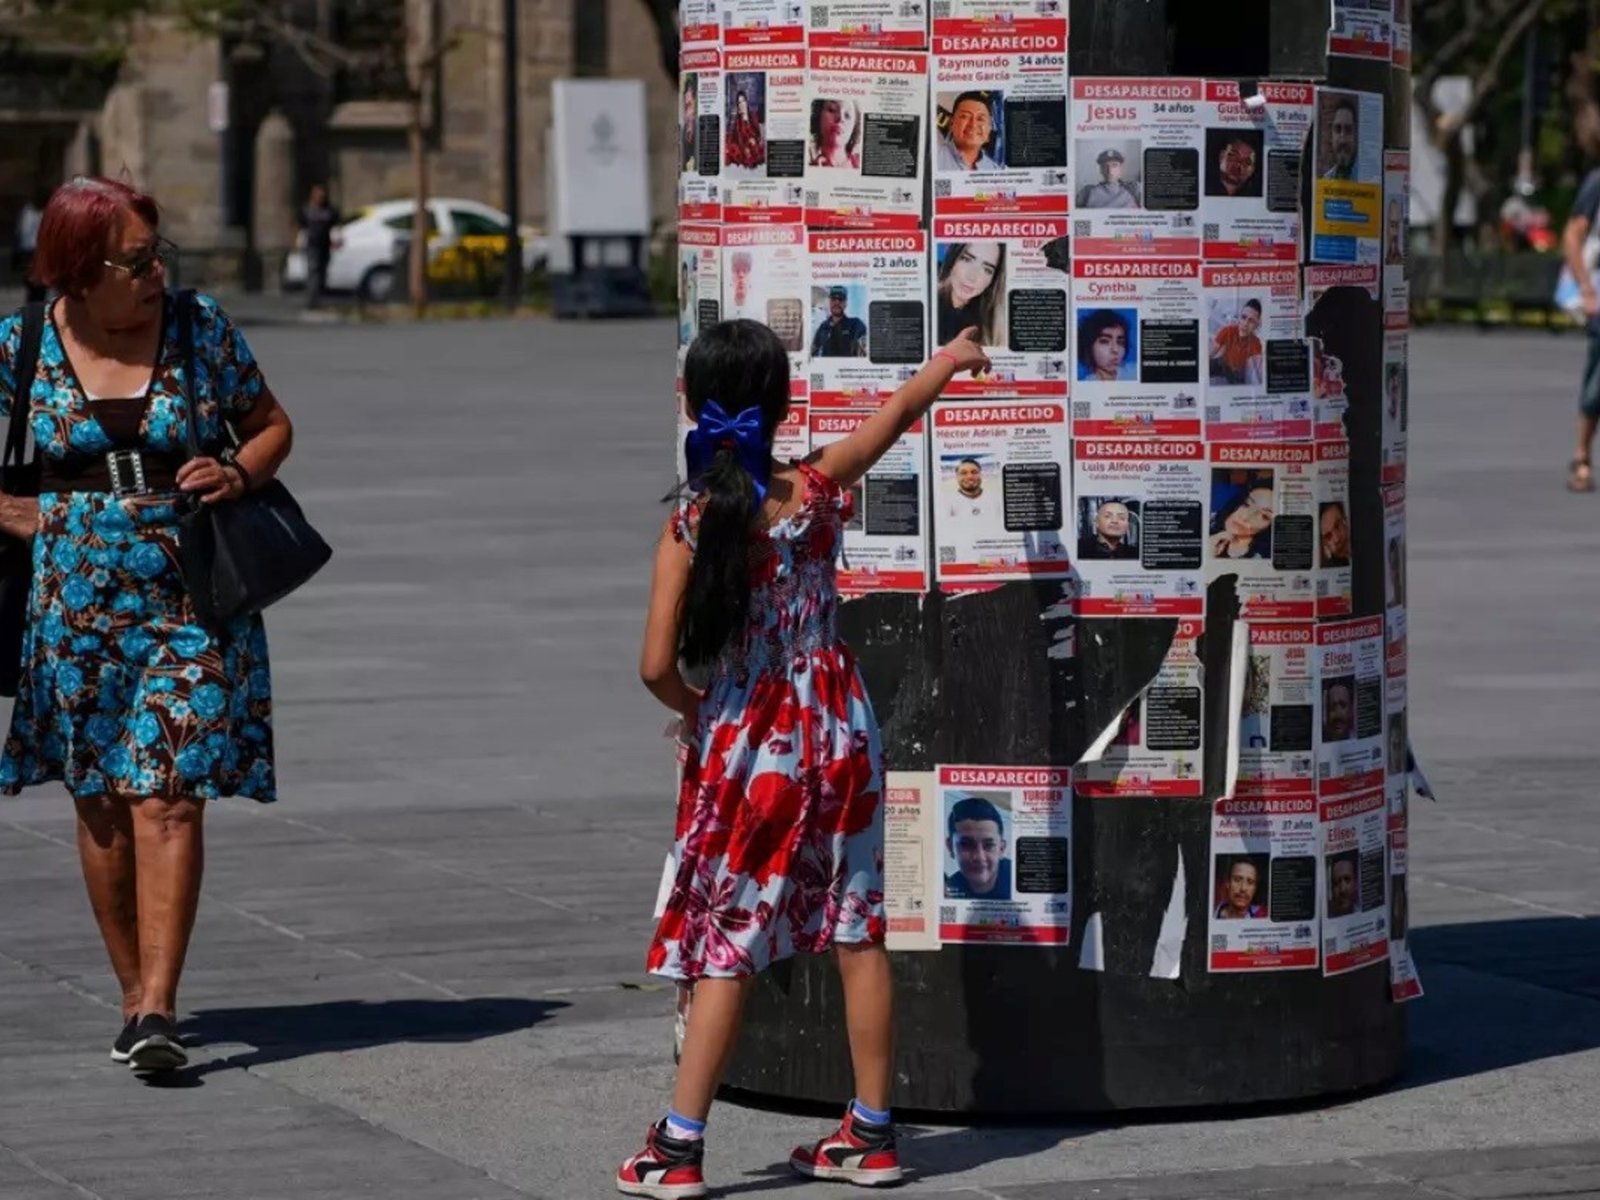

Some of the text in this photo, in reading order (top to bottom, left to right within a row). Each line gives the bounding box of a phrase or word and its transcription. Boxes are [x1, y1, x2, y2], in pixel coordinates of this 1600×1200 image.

[942, 36, 1058, 50] DESAPARECIDO
[728, 54, 798, 68] DESAPARECIDA
[818, 57, 917, 72] DESAPARECIDA
[938, 57, 1010, 70] Raymundo
[1018, 55, 1065, 66] 34 años
[1084, 85, 1192, 98] DESAPARECIDO
[1086, 104, 1137, 123] Jesus
[1152, 102, 1195, 113] 34 años
[727, 229, 795, 243] DESAPARECIDO
[944, 223, 1057, 236] DESAPARECIDA
[817, 237, 916, 250] DESAPARECIDO
[873, 256, 918, 268] 23 años
[1084, 263, 1194, 277] DESAPARECIDA
[1088, 282, 1137, 296] Cynthia
[945, 407, 1054, 422] DESAPARECIDO
[1025, 428, 1047, 436] años
[1086, 443, 1196, 455] DESAPARECIDO
[1219, 449, 1310, 462] DESAPARECIDA
[1082, 462, 1151, 472] Luis Alfonso
[950, 772, 1061, 784] DESAPARECIDO
[898, 806, 921, 815] años
[1225, 800, 1313, 813] DESAPARECIDO
